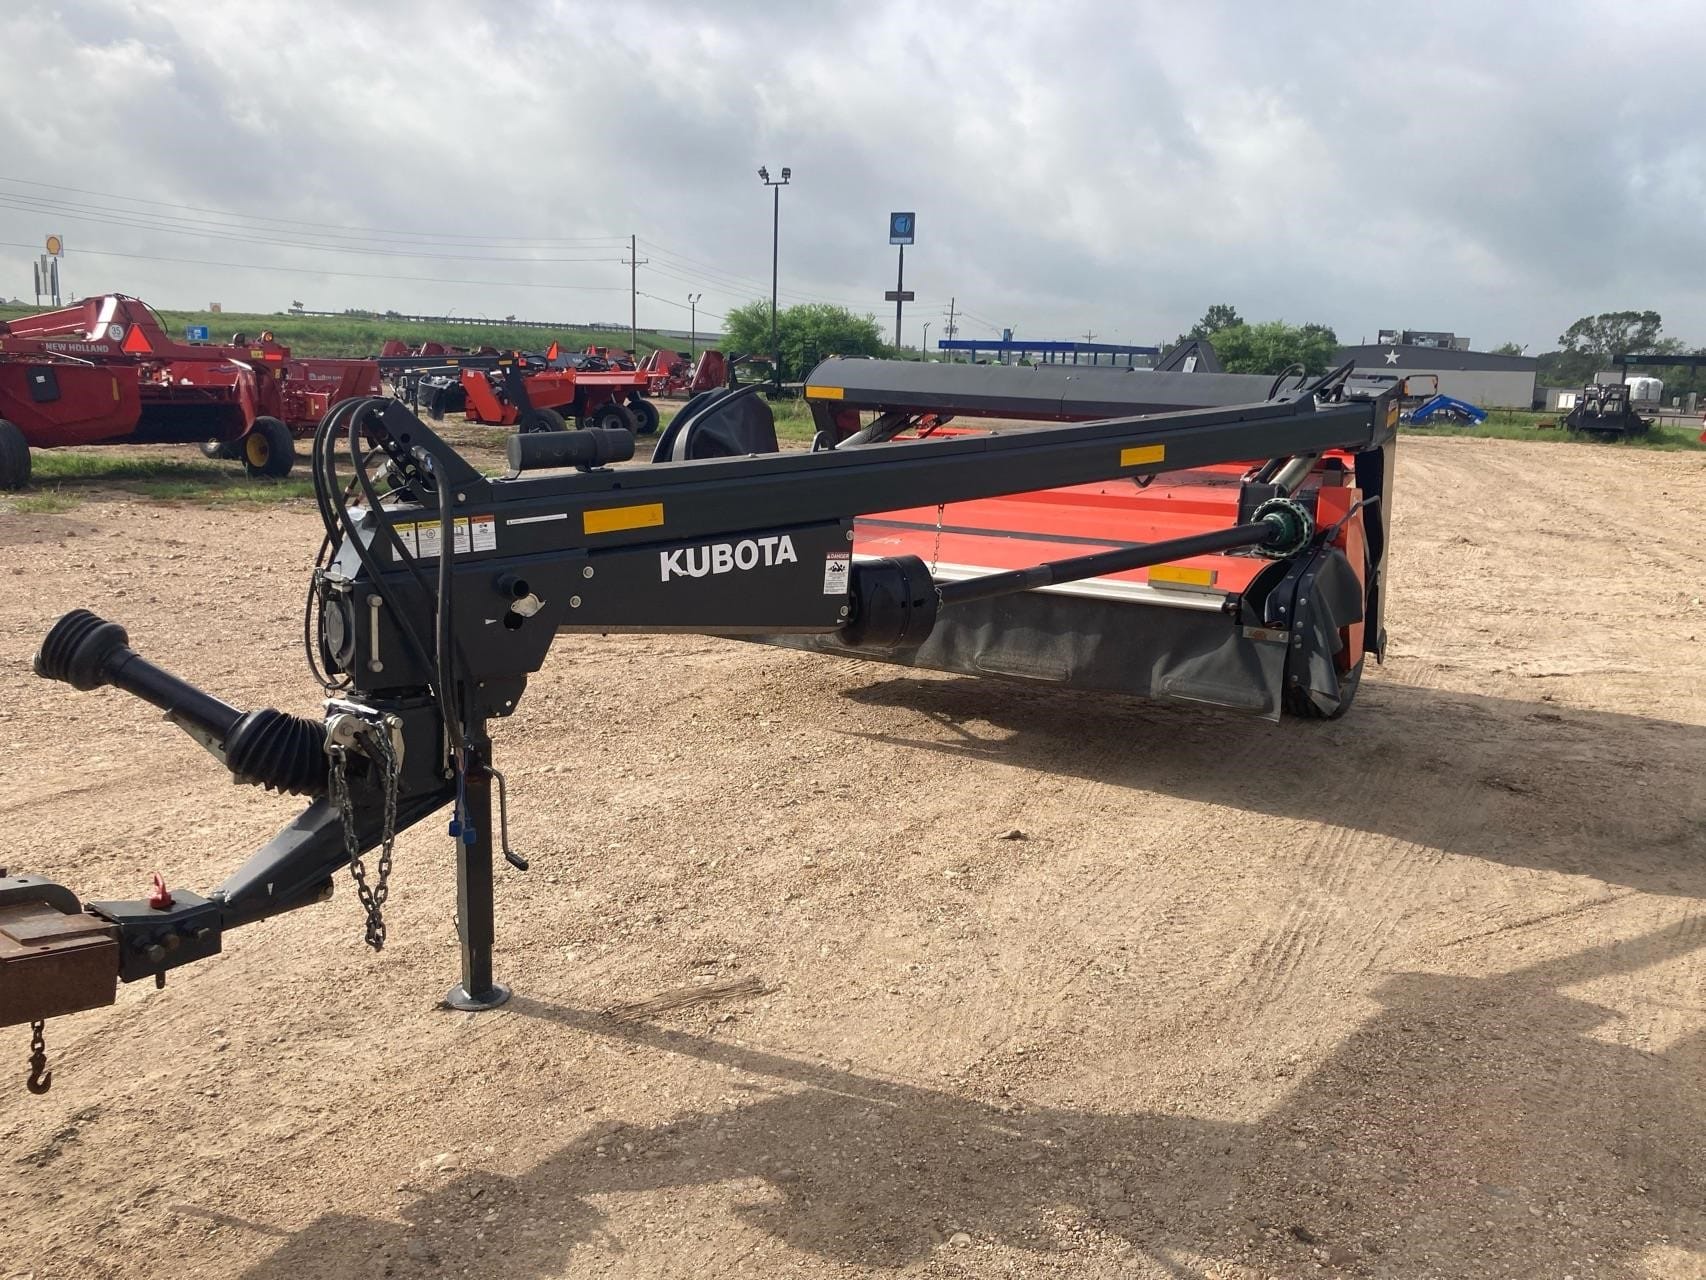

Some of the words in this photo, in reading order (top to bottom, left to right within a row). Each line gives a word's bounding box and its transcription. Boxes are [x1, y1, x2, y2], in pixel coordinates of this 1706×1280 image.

[111, 326, 121, 335] 35
[46, 343, 66, 351] NEW
[69, 343, 109, 353] HOLLAND
[660, 535, 797, 582] KUBOTA
